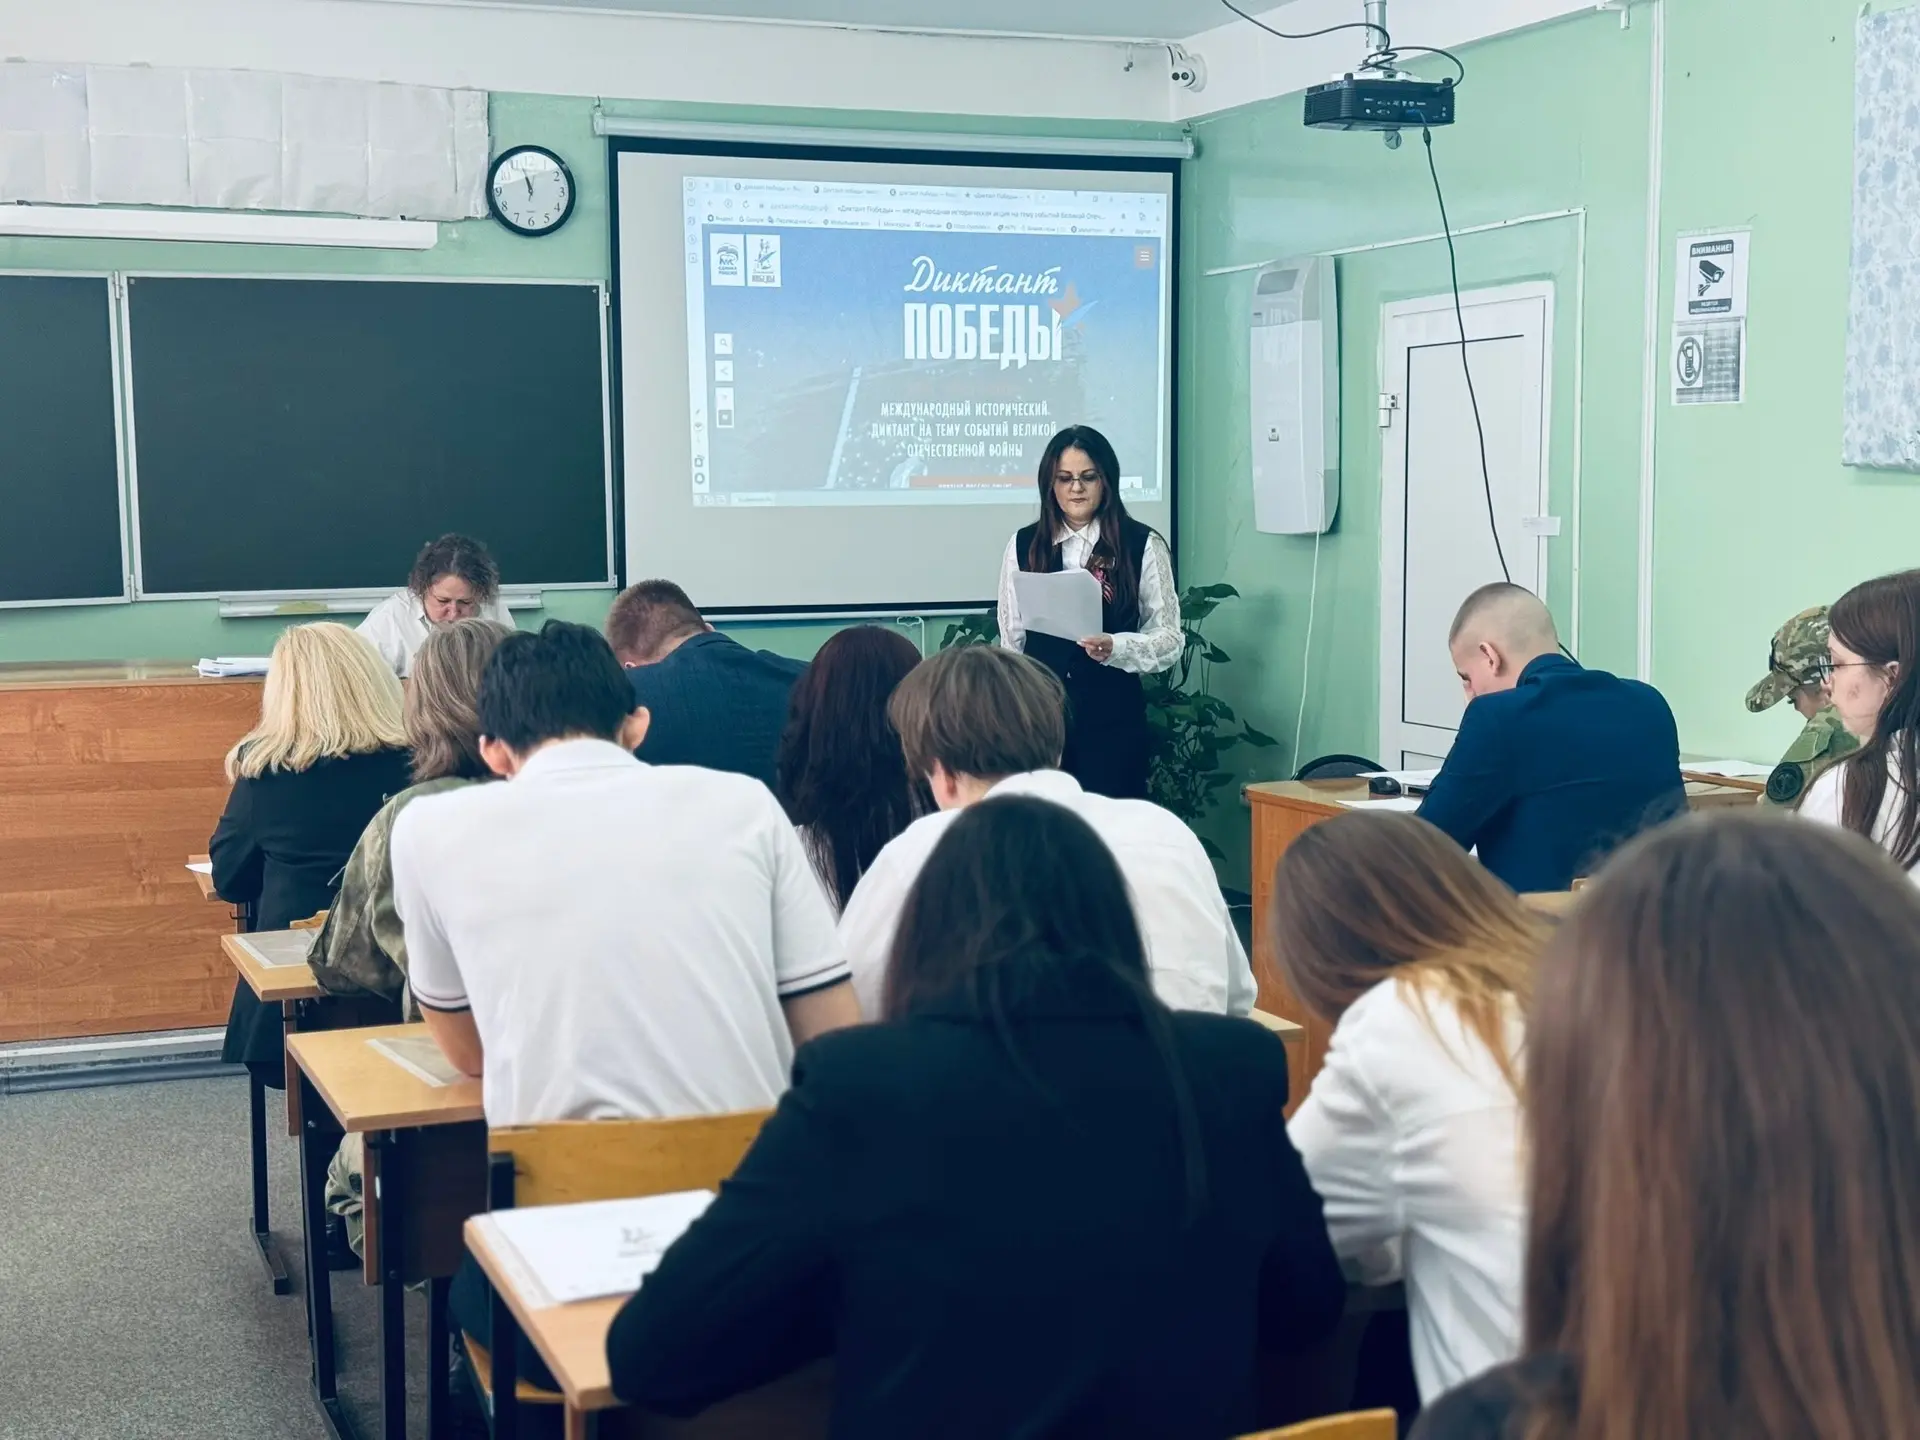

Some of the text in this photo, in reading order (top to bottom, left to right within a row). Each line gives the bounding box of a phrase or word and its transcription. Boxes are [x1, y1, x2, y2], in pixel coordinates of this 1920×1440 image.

[552, 171, 560, 182] 2
[495, 187, 502, 197] 9
[559, 187, 565, 197] 3
[501, 201, 508, 211] 8
[553, 203, 561, 212] 4
[513, 213, 520, 223] 7
[527, 217, 535, 227] 6
[543, 213, 550, 223] 5
[1691, 243, 1733, 256] ВНИМАНИЕ!
[903, 255, 1062, 294] Диктант
[904, 302, 1063, 371] ПОБЕДЫ
[880, 400, 1049, 418] МЕЖДУНАРОДНЫЙ ИСТОРИЧЕСКИЙ
[871, 421, 1058, 438] ДИКТАНТ НА ТЕМУ СОБЫТИЙ ВЕЛИКОЙ
[907, 441, 1023, 458] ОТЕЧЕСТВЕННОЙ ВОЙНЫ
